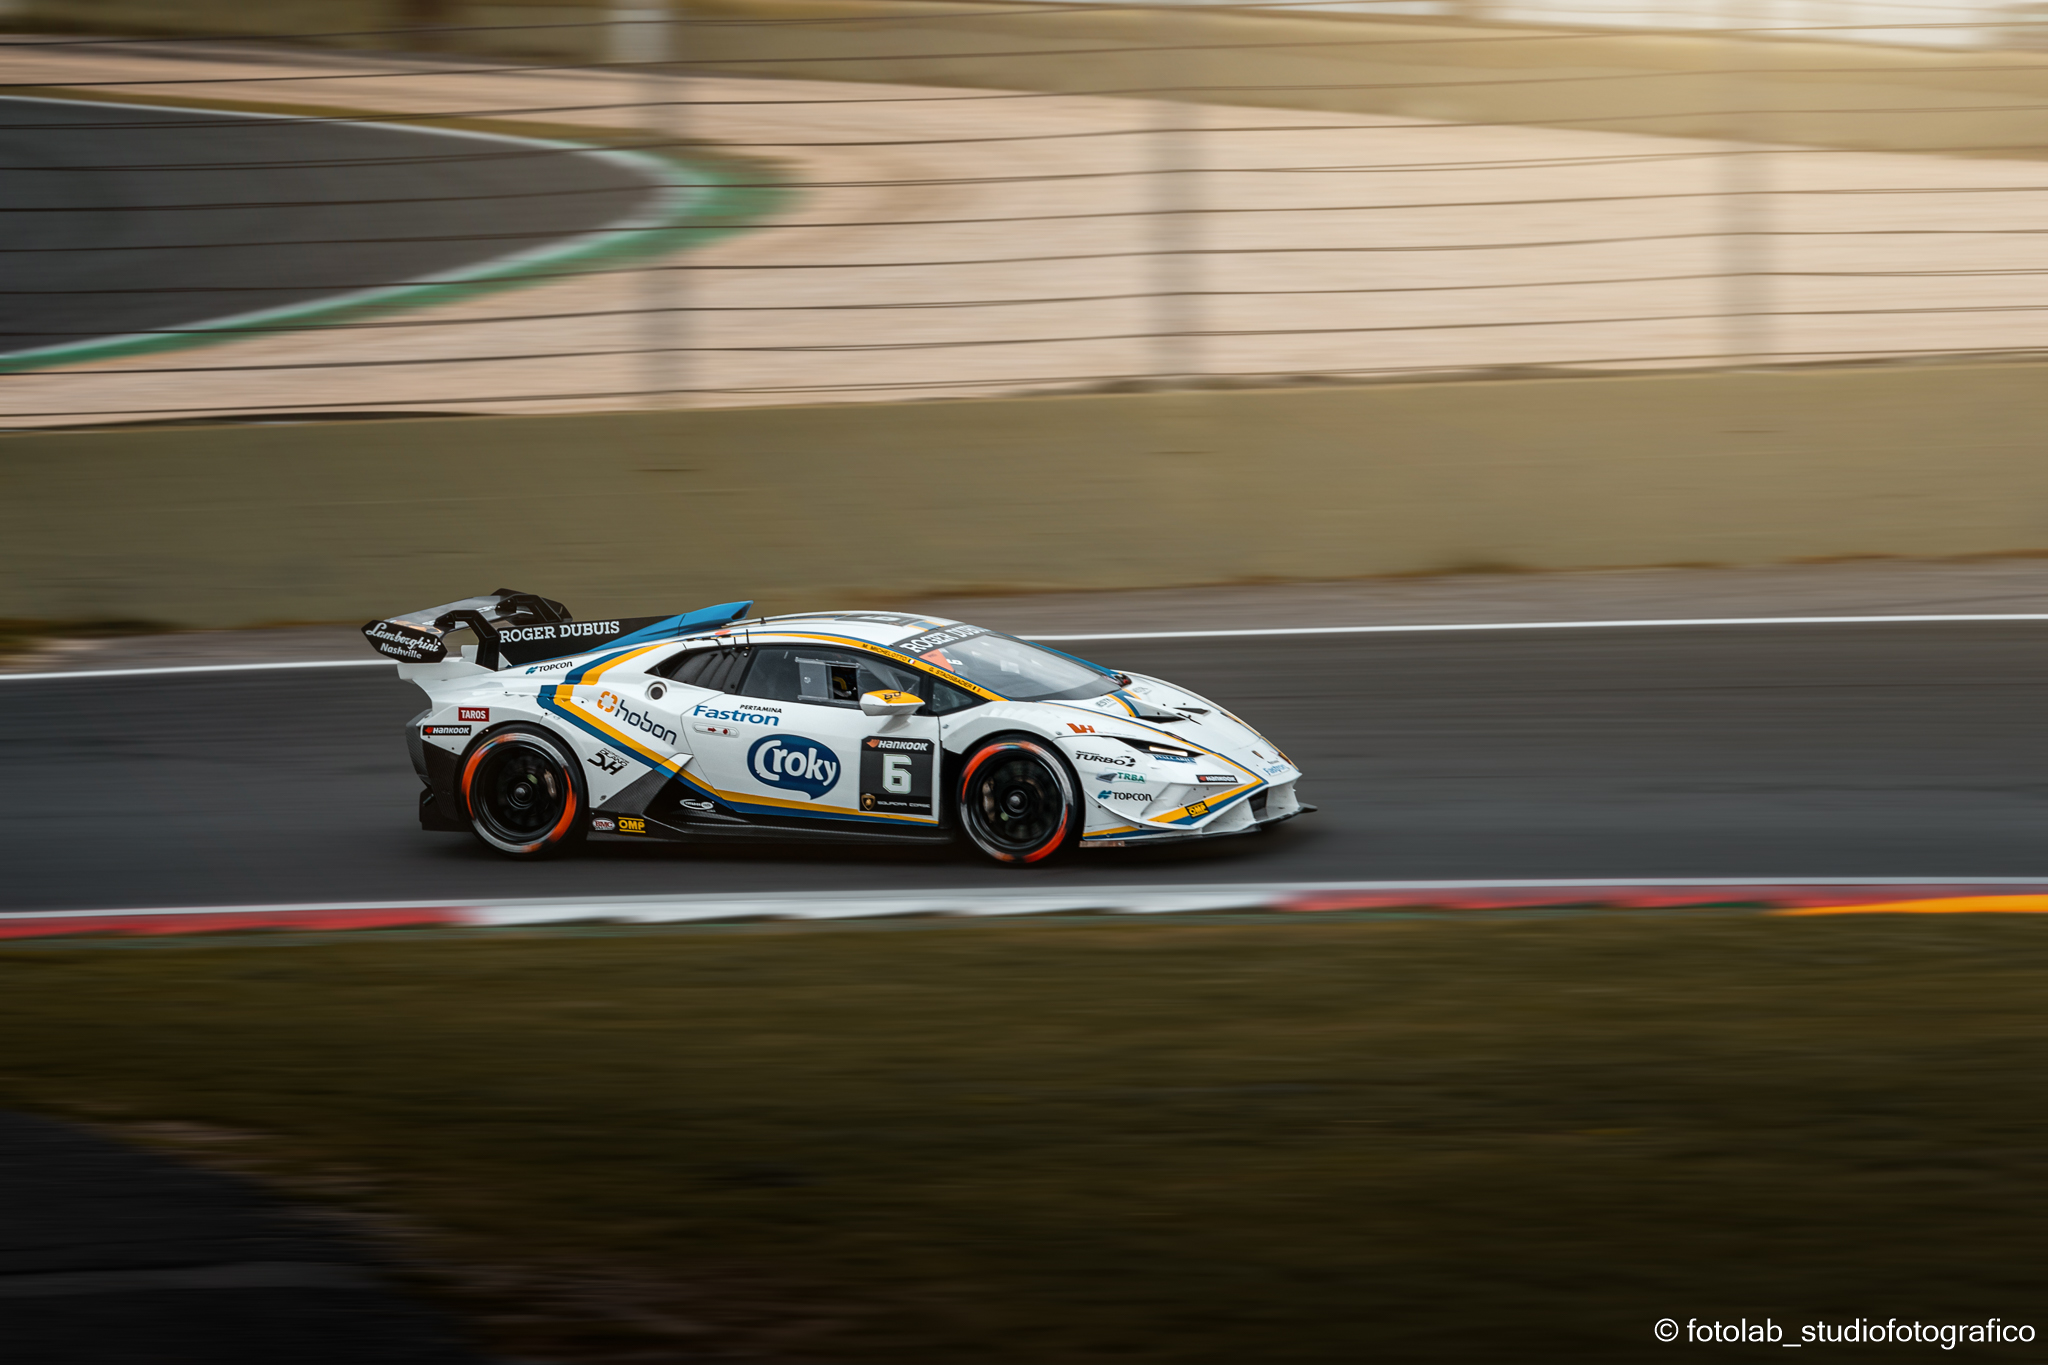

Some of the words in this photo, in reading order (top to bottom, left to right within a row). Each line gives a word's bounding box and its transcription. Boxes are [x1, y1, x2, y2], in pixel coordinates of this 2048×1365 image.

[366, 622, 441, 652] Lamborghini
[499, 626, 556, 643] ROGER
[560, 621, 620, 638] DUBUIS
[380, 643, 422, 659] Nashville
[538, 661, 573, 672] TOPCON
[461, 710, 486, 719] TAROS
[693, 705, 780, 727] Fastron
[739, 704, 782, 714] PERTAMINA
[614, 699, 677, 745] hobon
[754, 740, 837, 786] Croky
[882, 753, 912, 795] 6
[1117, 772, 1145, 783] TRBA
[1112, 791, 1153, 802] TOPCON
[619, 820, 646, 830] OMP
